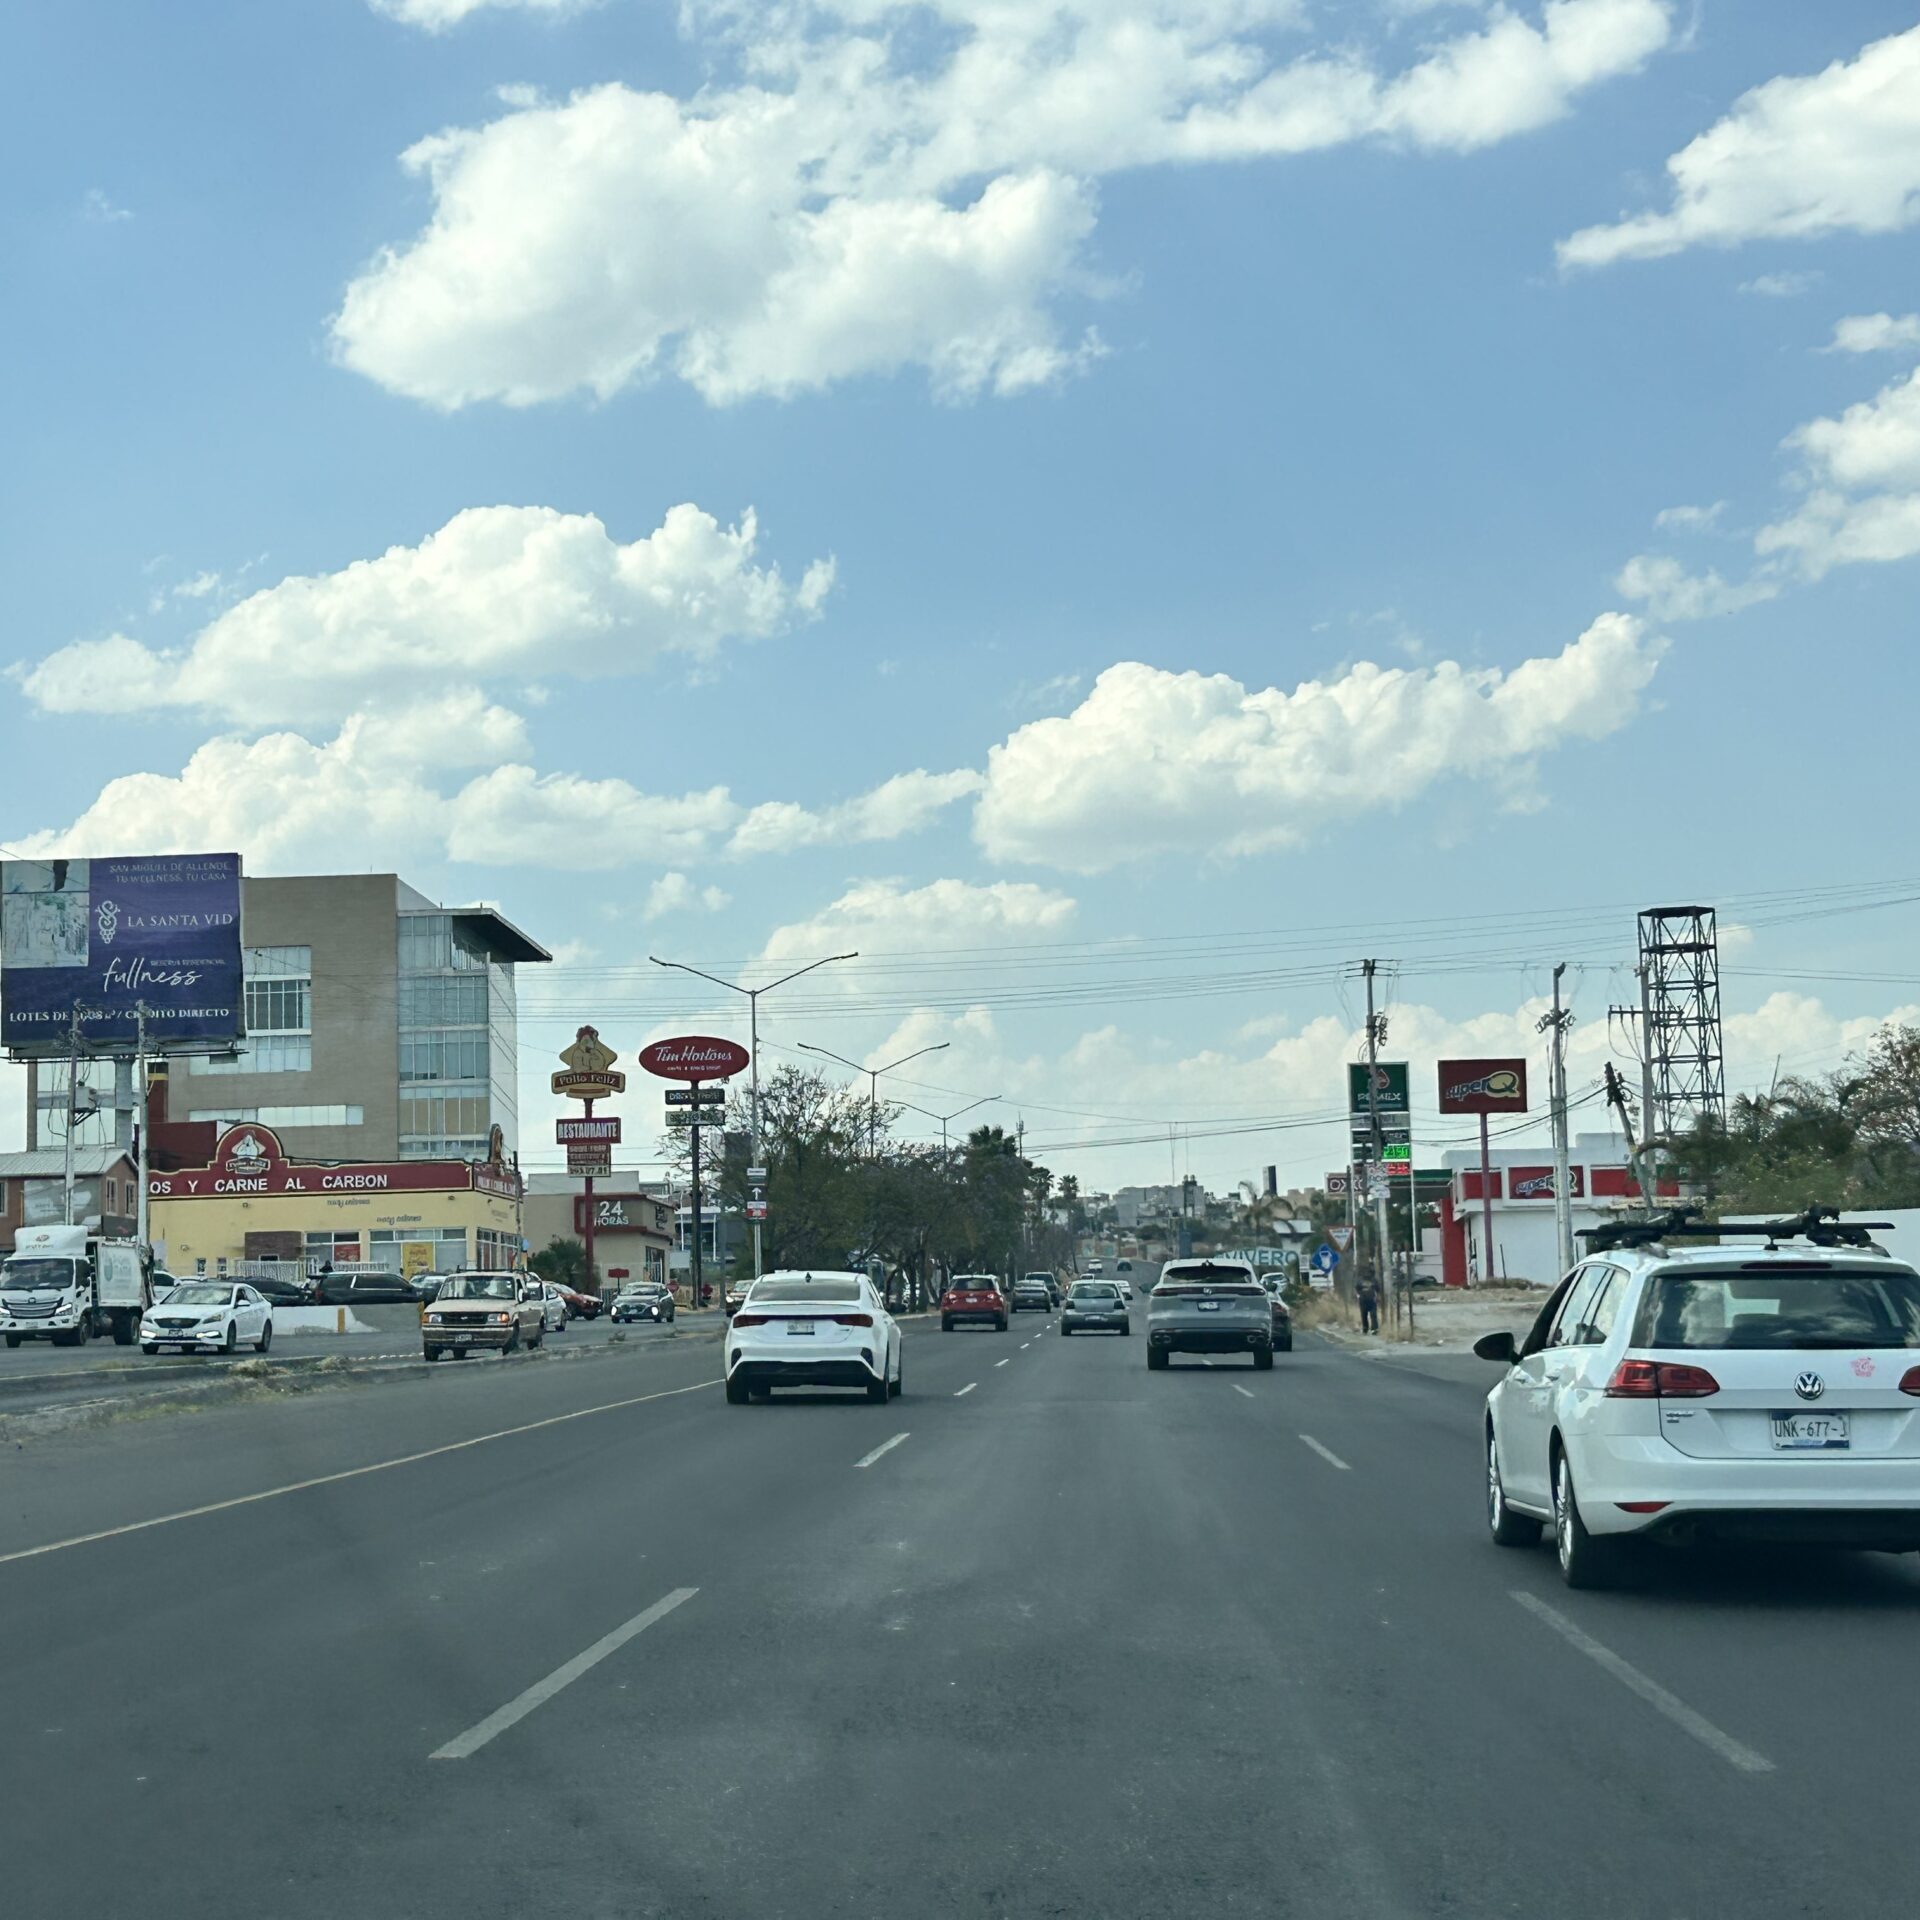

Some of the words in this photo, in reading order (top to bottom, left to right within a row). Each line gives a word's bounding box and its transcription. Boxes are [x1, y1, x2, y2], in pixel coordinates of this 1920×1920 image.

[110, 864, 129, 873] SAN
[131, 863, 167, 872] MIGUEL
[170, 862, 183, 871] DE
[201, 872, 227, 881] CASA
[128, 916, 144, 927] LA
[150, 914, 199, 927] SANTA
[204, 913, 233, 925] VID
[103, 957, 202, 992] fullness
[10, 1011, 50, 1022] LOTES
[53, 1011, 69, 1021] DE
[125, 1009, 176, 1019] CRDITO
[178, 1008, 229, 1018] DIRECTO
[655, 1046, 679, 1062] Tim
[681, 1045, 732, 1061] Hortons
[559, 1074, 587, 1086] Pollo
[590, 1074, 616, 1085] Feliz
[557, 1122, 617, 1139] RESTAURANTE
[188, 1180, 198, 1193] Y
[214, 1178, 268, 1192] CARNE
[285, 1177, 306, 1190] AL
[322, 1174, 387, 1189] CARBON
[600, 1200, 624, 1216] 24
[594, 1216, 629, 1227] HORAS
